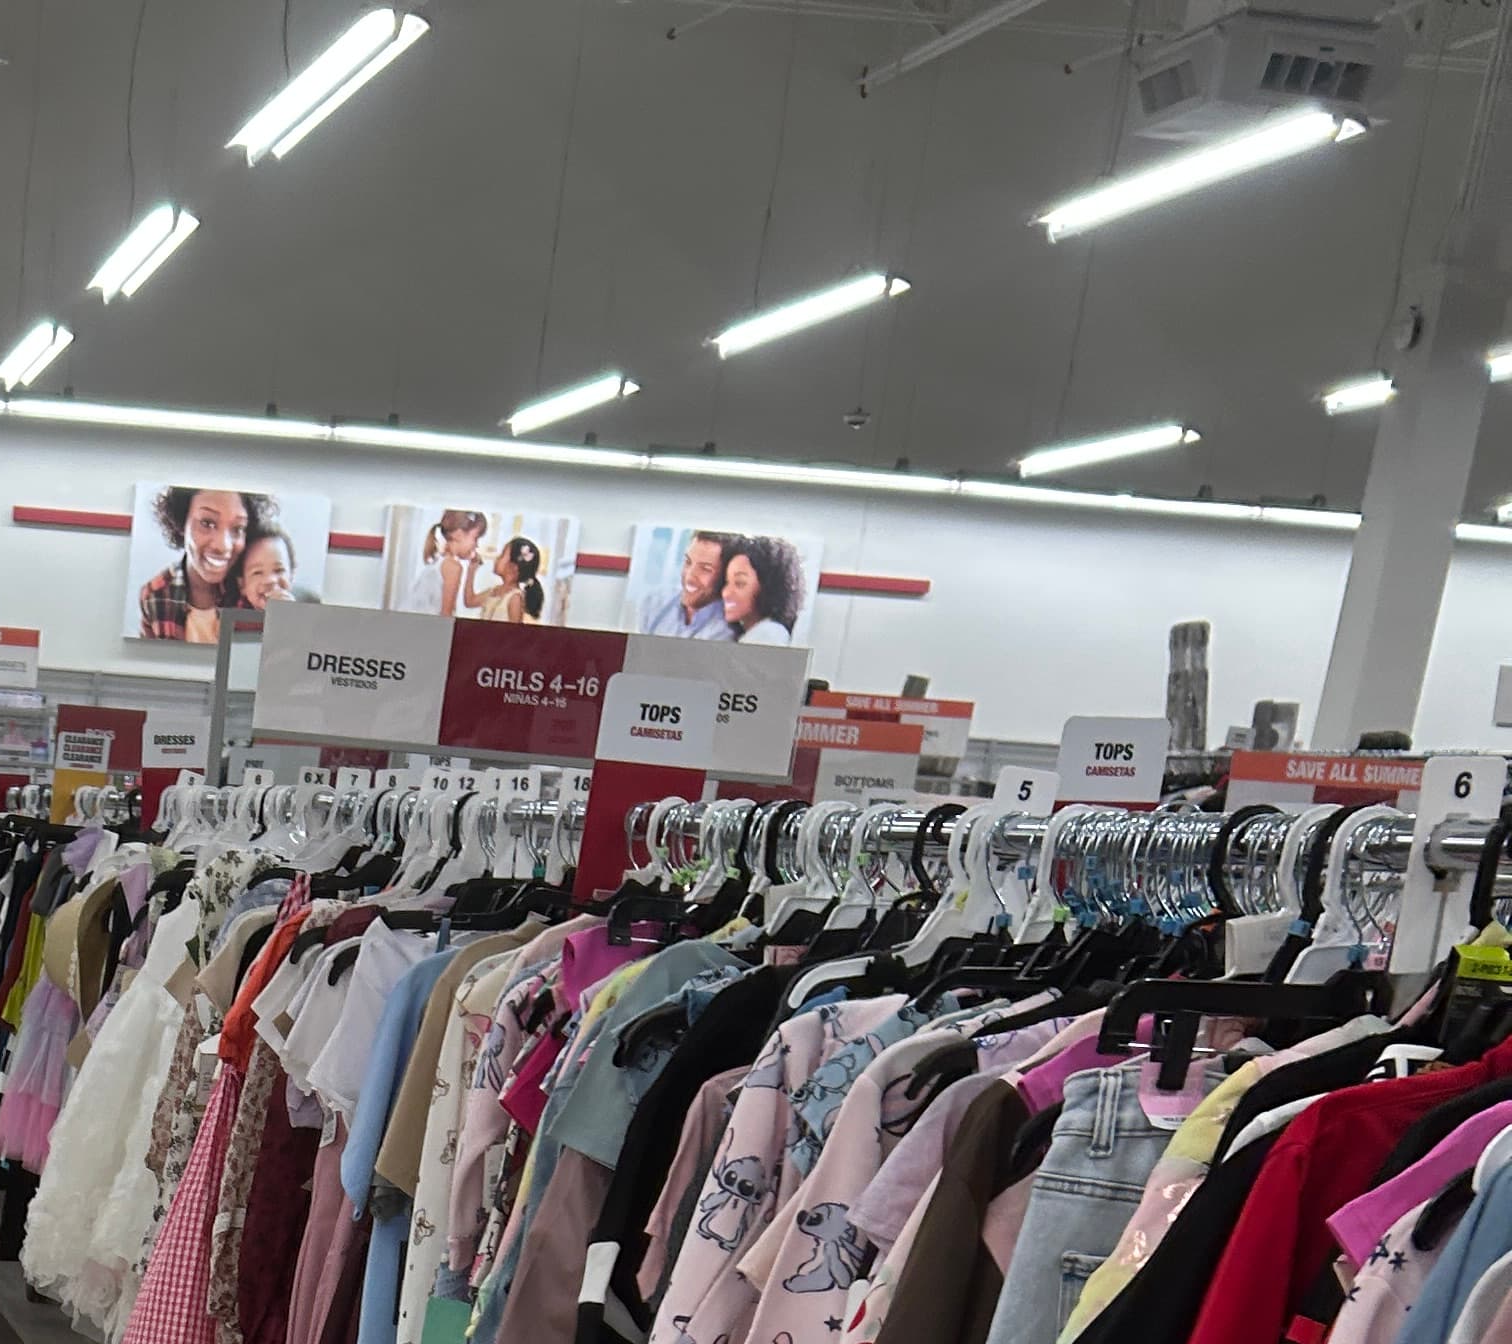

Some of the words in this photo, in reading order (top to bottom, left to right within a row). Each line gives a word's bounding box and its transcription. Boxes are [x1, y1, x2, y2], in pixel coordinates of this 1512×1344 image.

[307, 652, 407, 681] DRESSES
[330, 677, 378, 691] VESTIDOS
[477, 667, 544, 693] GIRLS
[549, 675, 600, 698] 4-16
[718, 692, 759, 713] SES
[845, 695, 871, 709] SAVE
[873, 697, 891, 710] ALL
[639, 703, 682, 724] TOPS
[64, 735, 105, 746] CLEARANCE
[153, 734, 196, 745] DRESSES
[630, 726, 683, 741] CAMISETAS
[63, 744, 104, 754] CLEARANCE
[1095, 743, 1135, 761] TOPS
[62, 752, 103, 763] CLEARANCE
[1085, 765, 1136, 777] CAMISETAS
[1285, 760, 1326, 780] SAVE
[1329, 764, 1357, 782] ALL
[253, 774, 263, 786] 6
[350, 774, 359, 786] 7
[388, 775, 397, 787] 8
[432, 777, 449, 791] 10
[458, 777, 476, 791] 12
[511, 777, 530, 791] 16
[573, 776, 591, 791] 18
[1454, 772, 1473, 798] 6
[1017, 780, 1033, 801] 5
